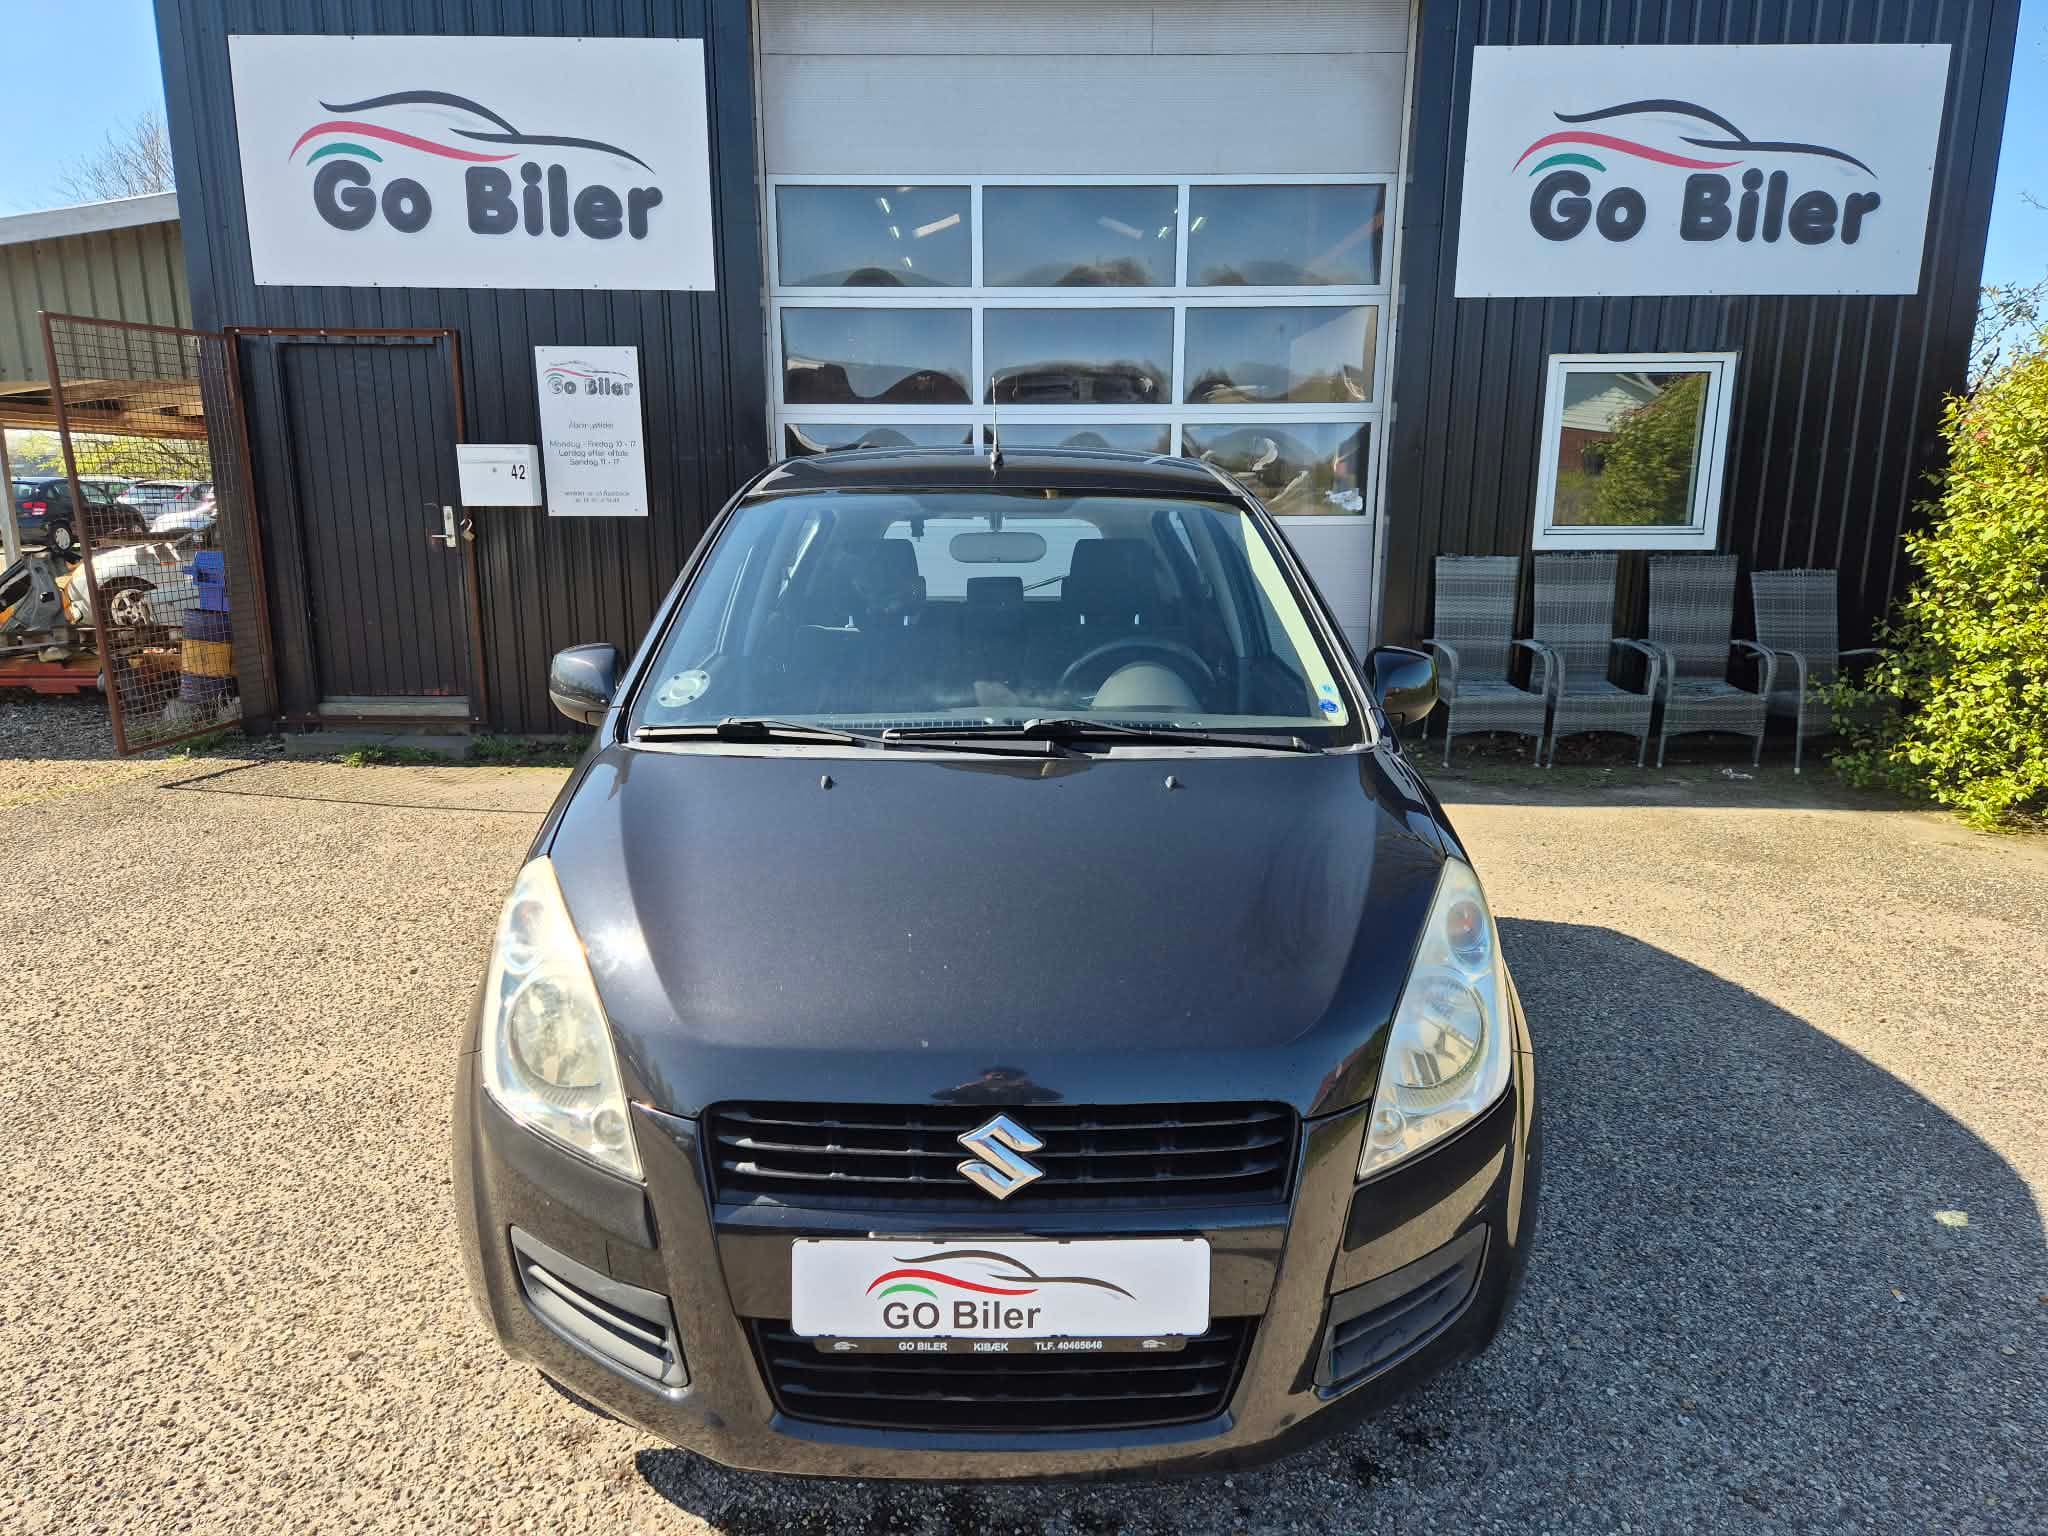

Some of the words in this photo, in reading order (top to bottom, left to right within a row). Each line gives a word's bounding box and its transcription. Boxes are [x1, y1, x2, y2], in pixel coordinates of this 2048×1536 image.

[314, 159, 432, 233] Go
[465, 161, 663, 240] Biler
[1529, 170, 1647, 242] Go
[1679, 167, 1881, 245] Biler
[548, 376, 576, 394] Go
[584, 376, 634, 396] Biler
[511, 464, 526, 480] 42
[882, 1300, 941, 1330] GO
[952, 1299, 1042, 1330] Biler
[898, 1342, 915, 1351] GO
[917, 1342, 948, 1351] BILER
[973, 1342, 1009, 1352] KIBÆK
[1035, 1342, 1055, 1351] TLF.
